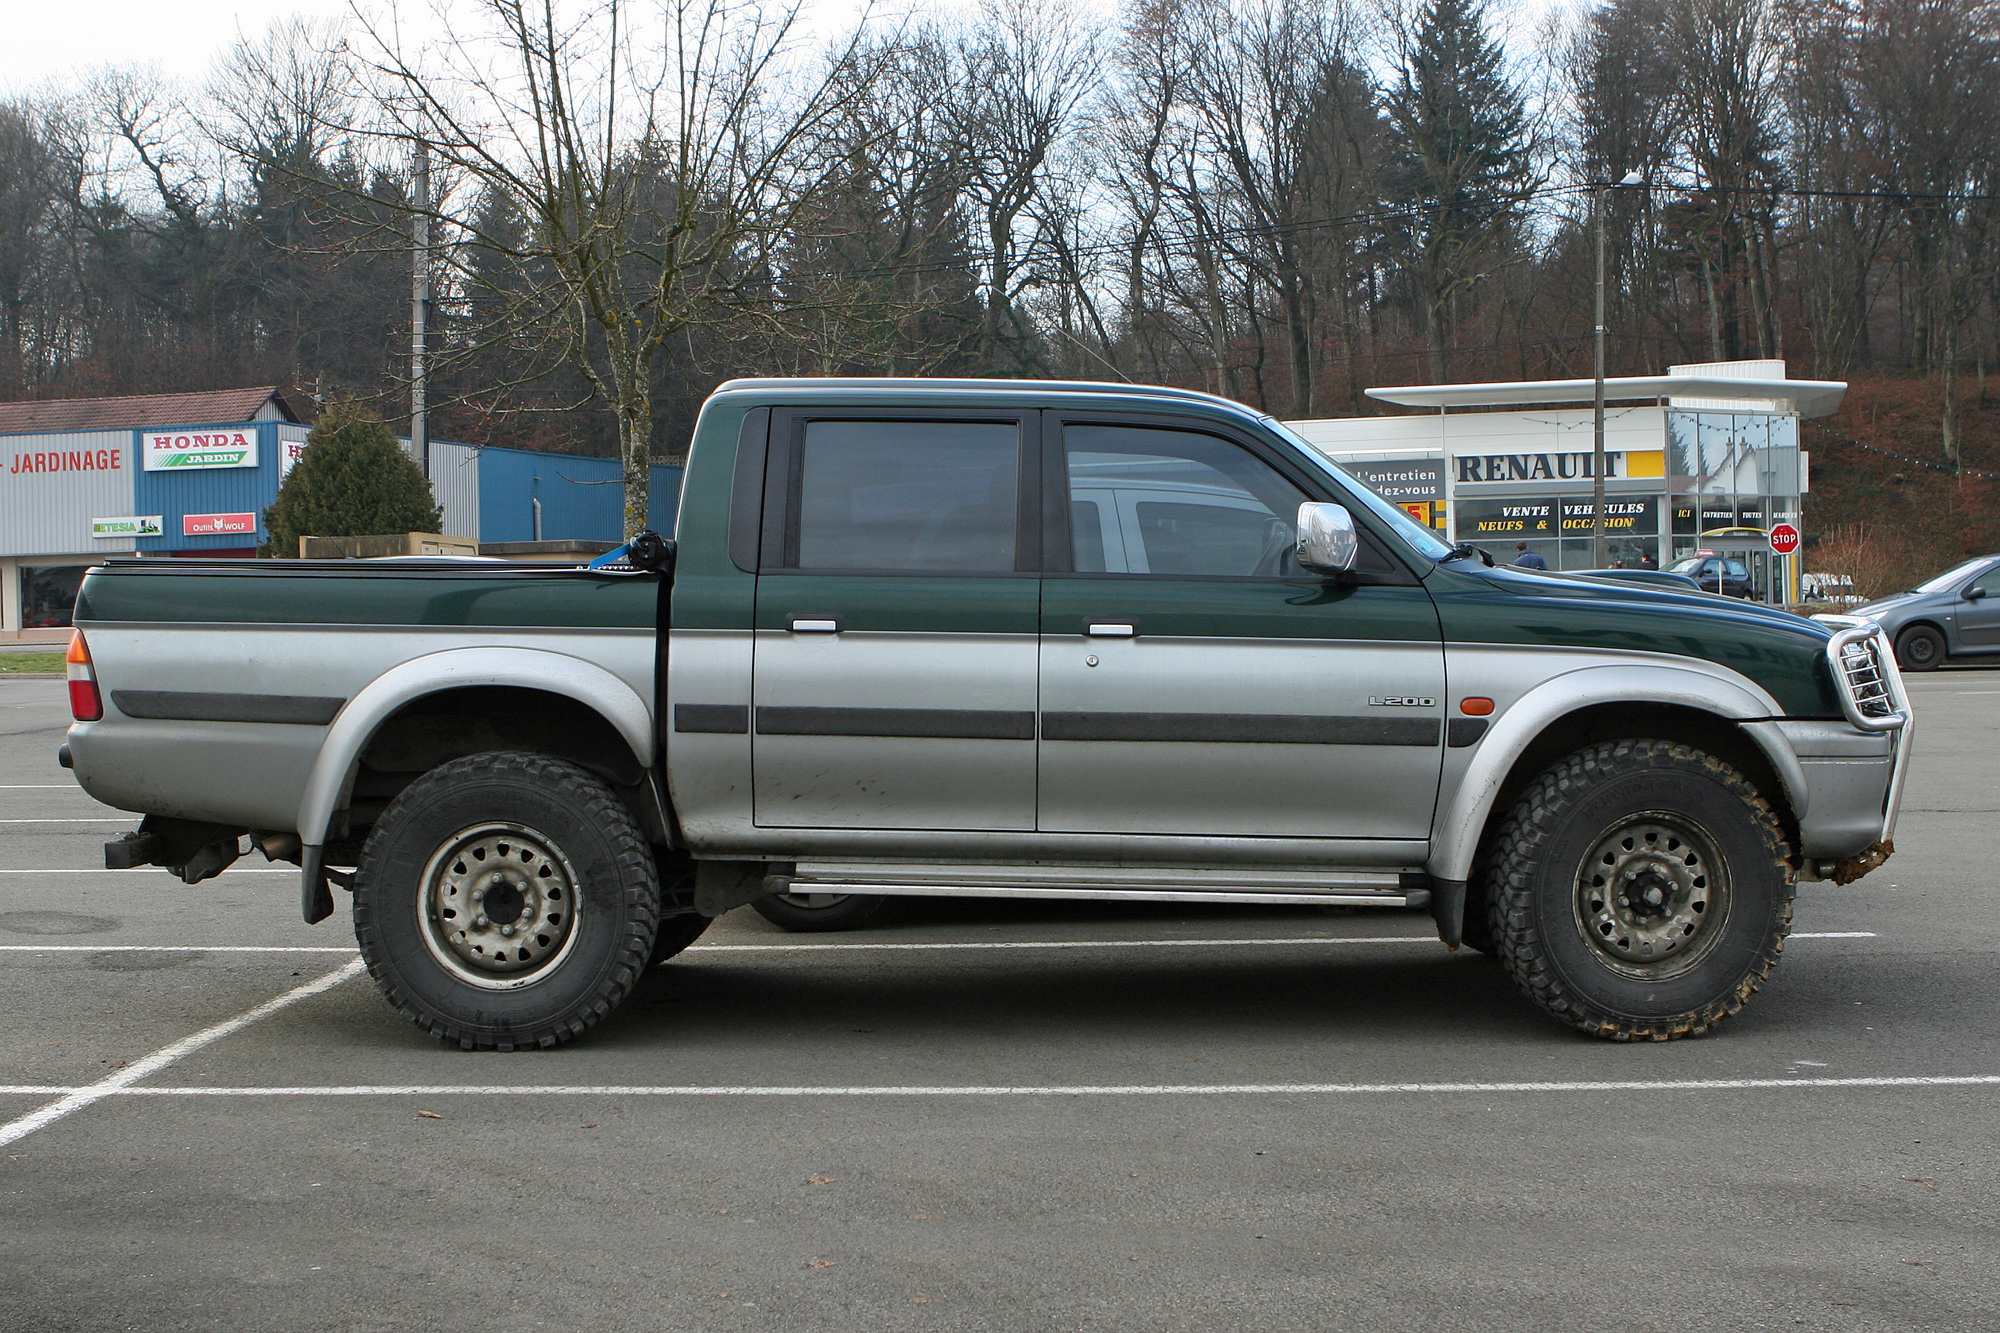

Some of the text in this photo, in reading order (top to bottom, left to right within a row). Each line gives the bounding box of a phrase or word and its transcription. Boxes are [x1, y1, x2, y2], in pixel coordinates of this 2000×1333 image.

[153, 433, 248, 449] HONDA
[10, 449, 121, 474] JARDINAGE
[186, 453, 240, 464] JARDIN
[1457, 452, 1621, 482] RENAULT
[1376, 484, 1436, 496] dez-vous
[1502, 502, 1645, 517] VENTE VEHULES
[1677, 509, 1692, 518] ICI
[192, 522, 246, 532] Outils WOLF
[1477, 520, 1524, 531] NEUFS
[1536, 519, 1548, 530] &
[1772, 533, 1797, 545] STOP
[1368, 695, 1437, 707] L200
